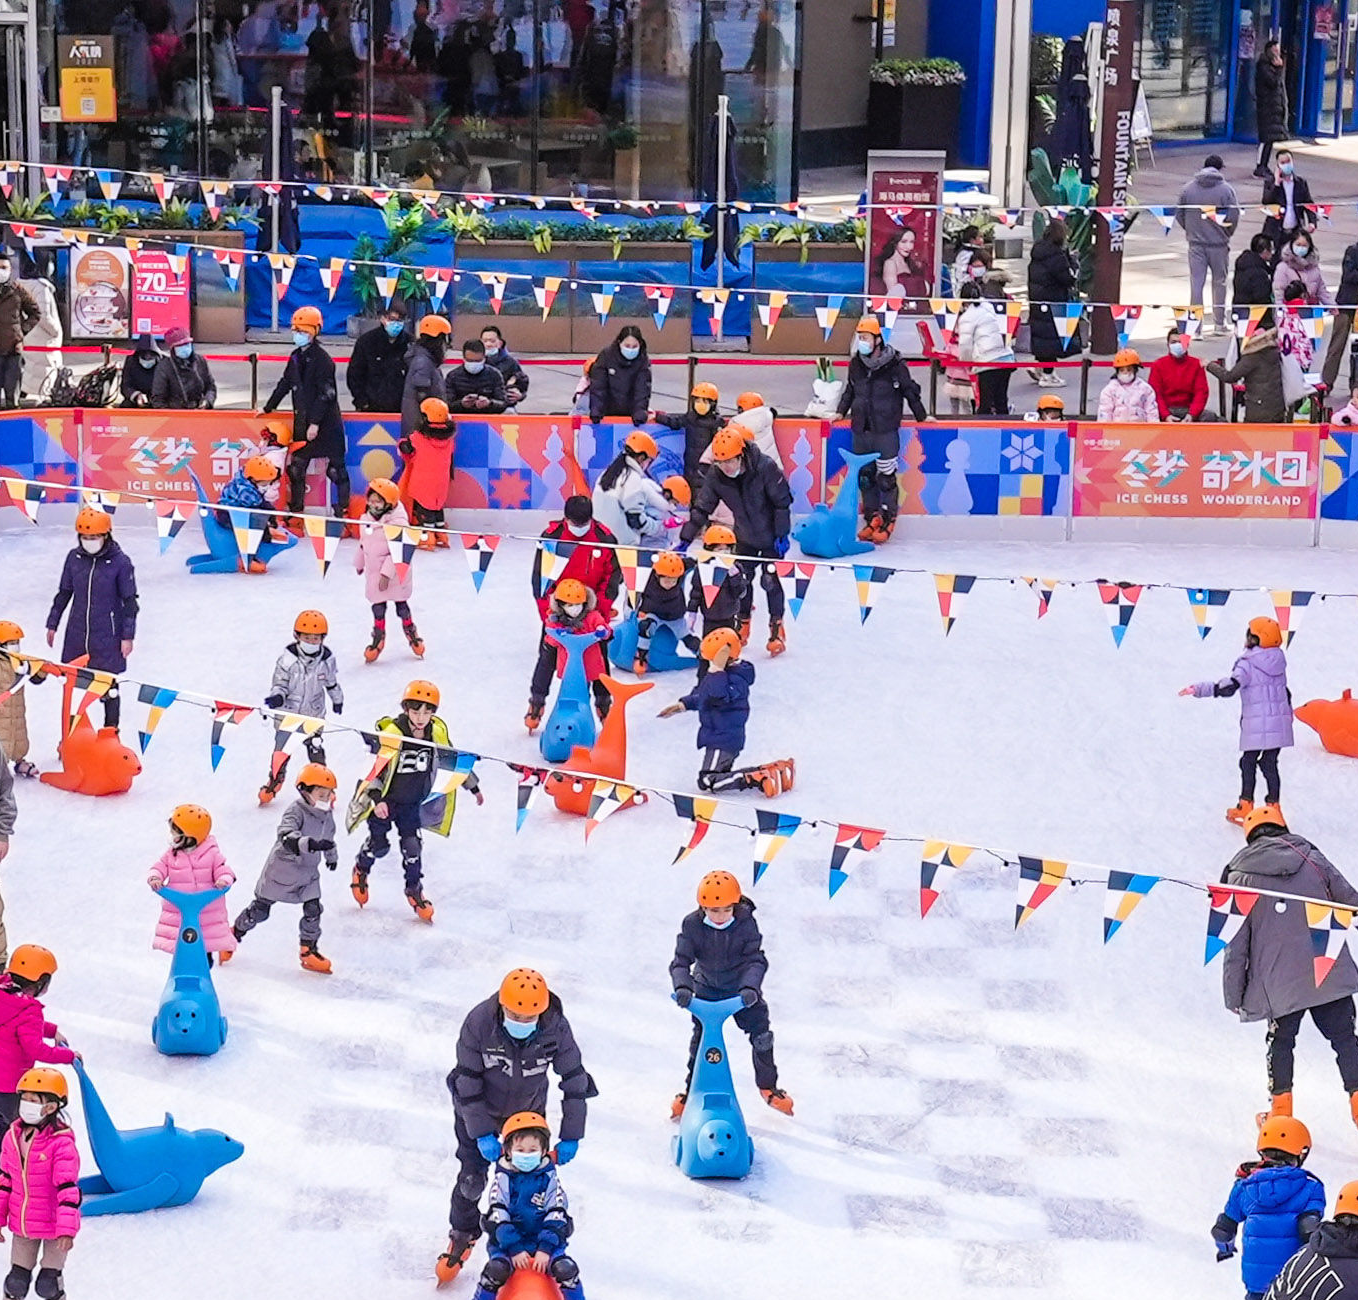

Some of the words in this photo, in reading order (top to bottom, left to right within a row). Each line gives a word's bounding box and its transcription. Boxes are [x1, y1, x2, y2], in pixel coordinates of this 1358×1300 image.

[1113, 110, 1132, 188] FOUNTAIN
[1120, 449, 1190, 488] 冬梦
[127, 480, 150, 491] ICE
[1117, 493, 1139, 504] ICE
[1144, 493, 1188, 504] CHESS
[1202, 494, 1301, 506] WONDERLAND
[707, 1052, 720, 1063] 26
